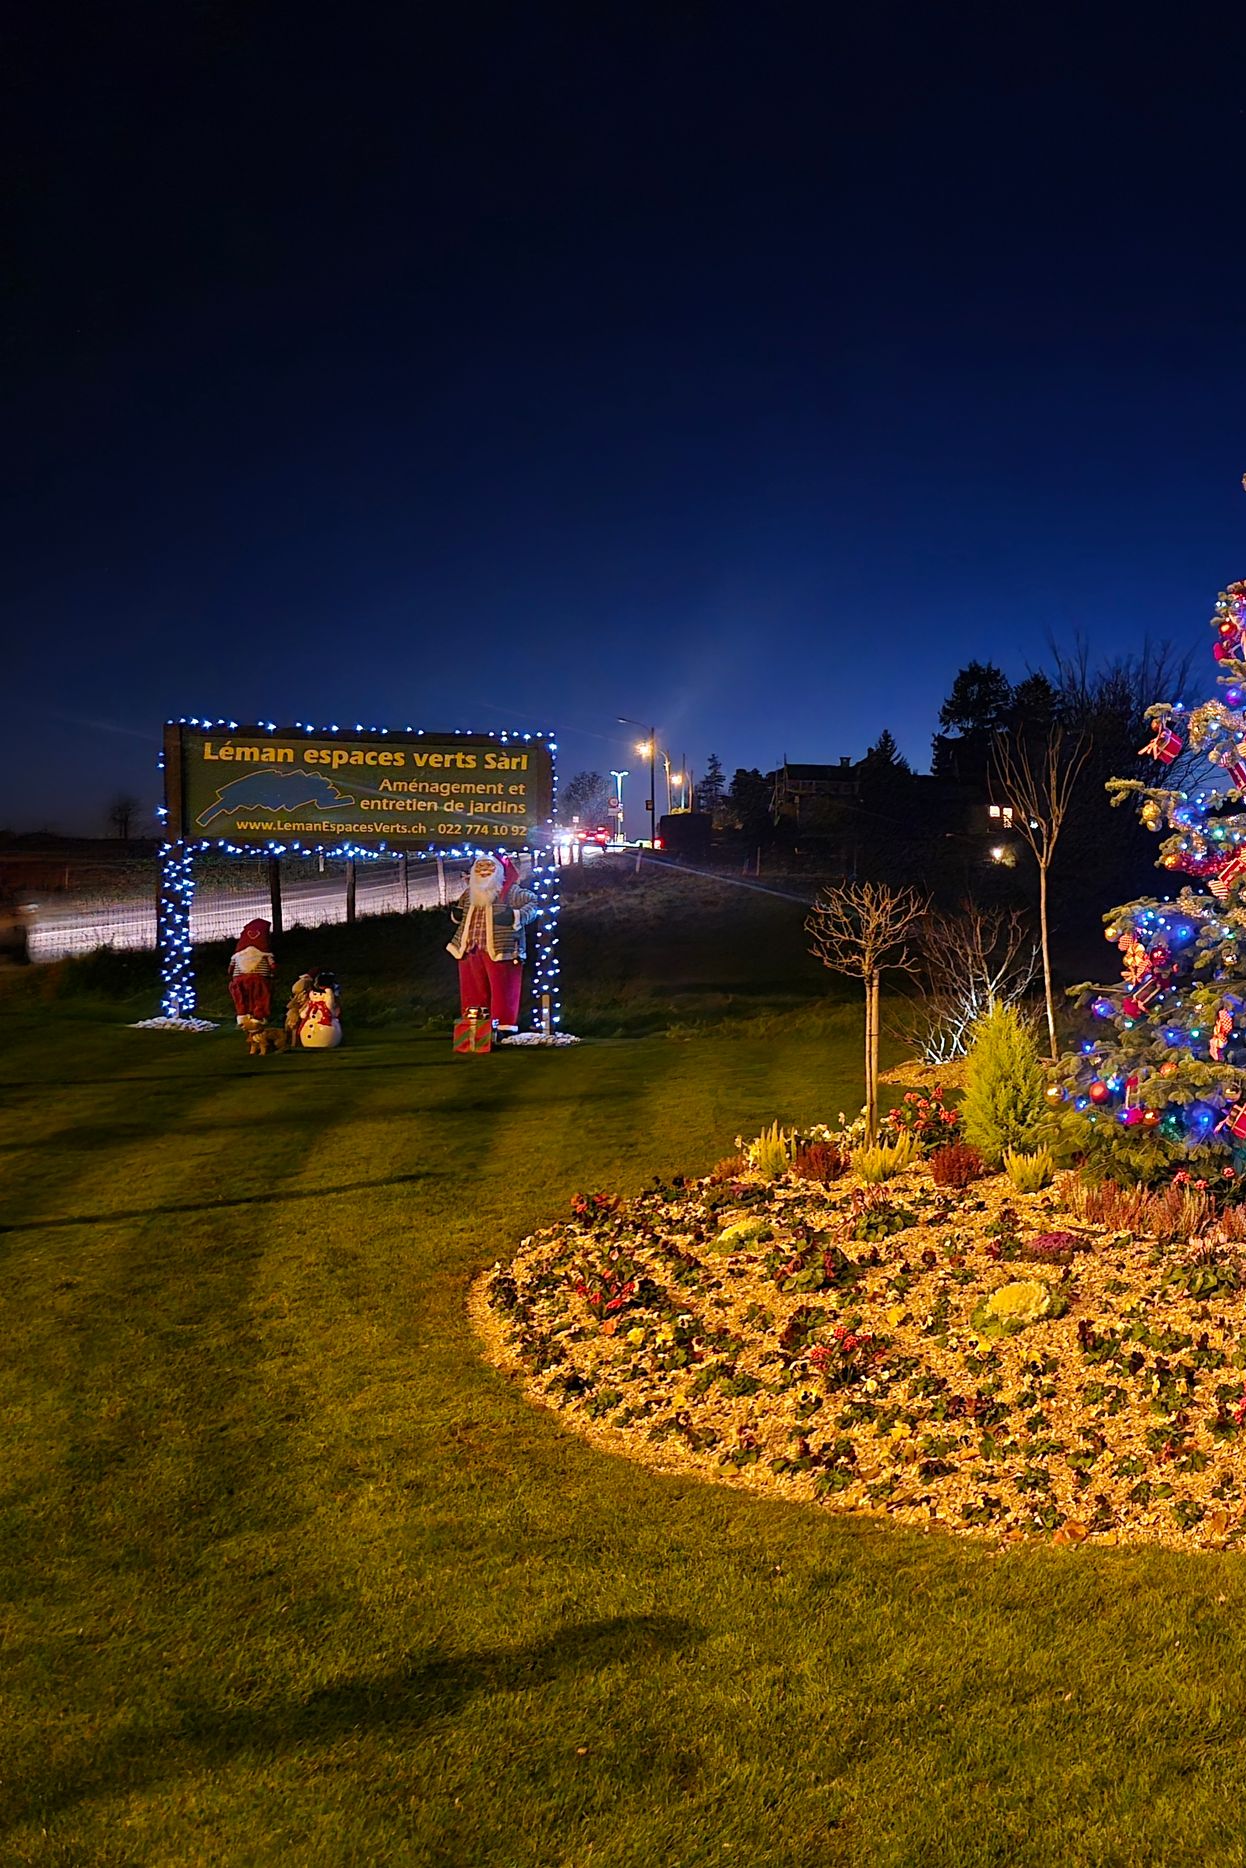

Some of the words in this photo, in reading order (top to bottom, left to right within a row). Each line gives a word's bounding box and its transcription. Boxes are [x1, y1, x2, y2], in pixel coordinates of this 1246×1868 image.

[203, 740, 294, 763] Léman
[304, 749, 405, 769] espaces
[413, 751, 477, 769] verts
[484, 751, 529, 770] Sàrl
[379, 778, 504, 796] Aménagement
[508, 783, 526, 796] et
[360, 798, 438, 812] entretien
[443, 799, 465, 813] de
[466, 799, 527, 816] jardins
[236, 820, 427, 834] www.LemanEspacesVerts.ch
[437, 823, 462, 835] 022
[465, 824, 489, 836] 774
[492, 825, 508, 836] 10
[511, 825, 528, 837] 92
